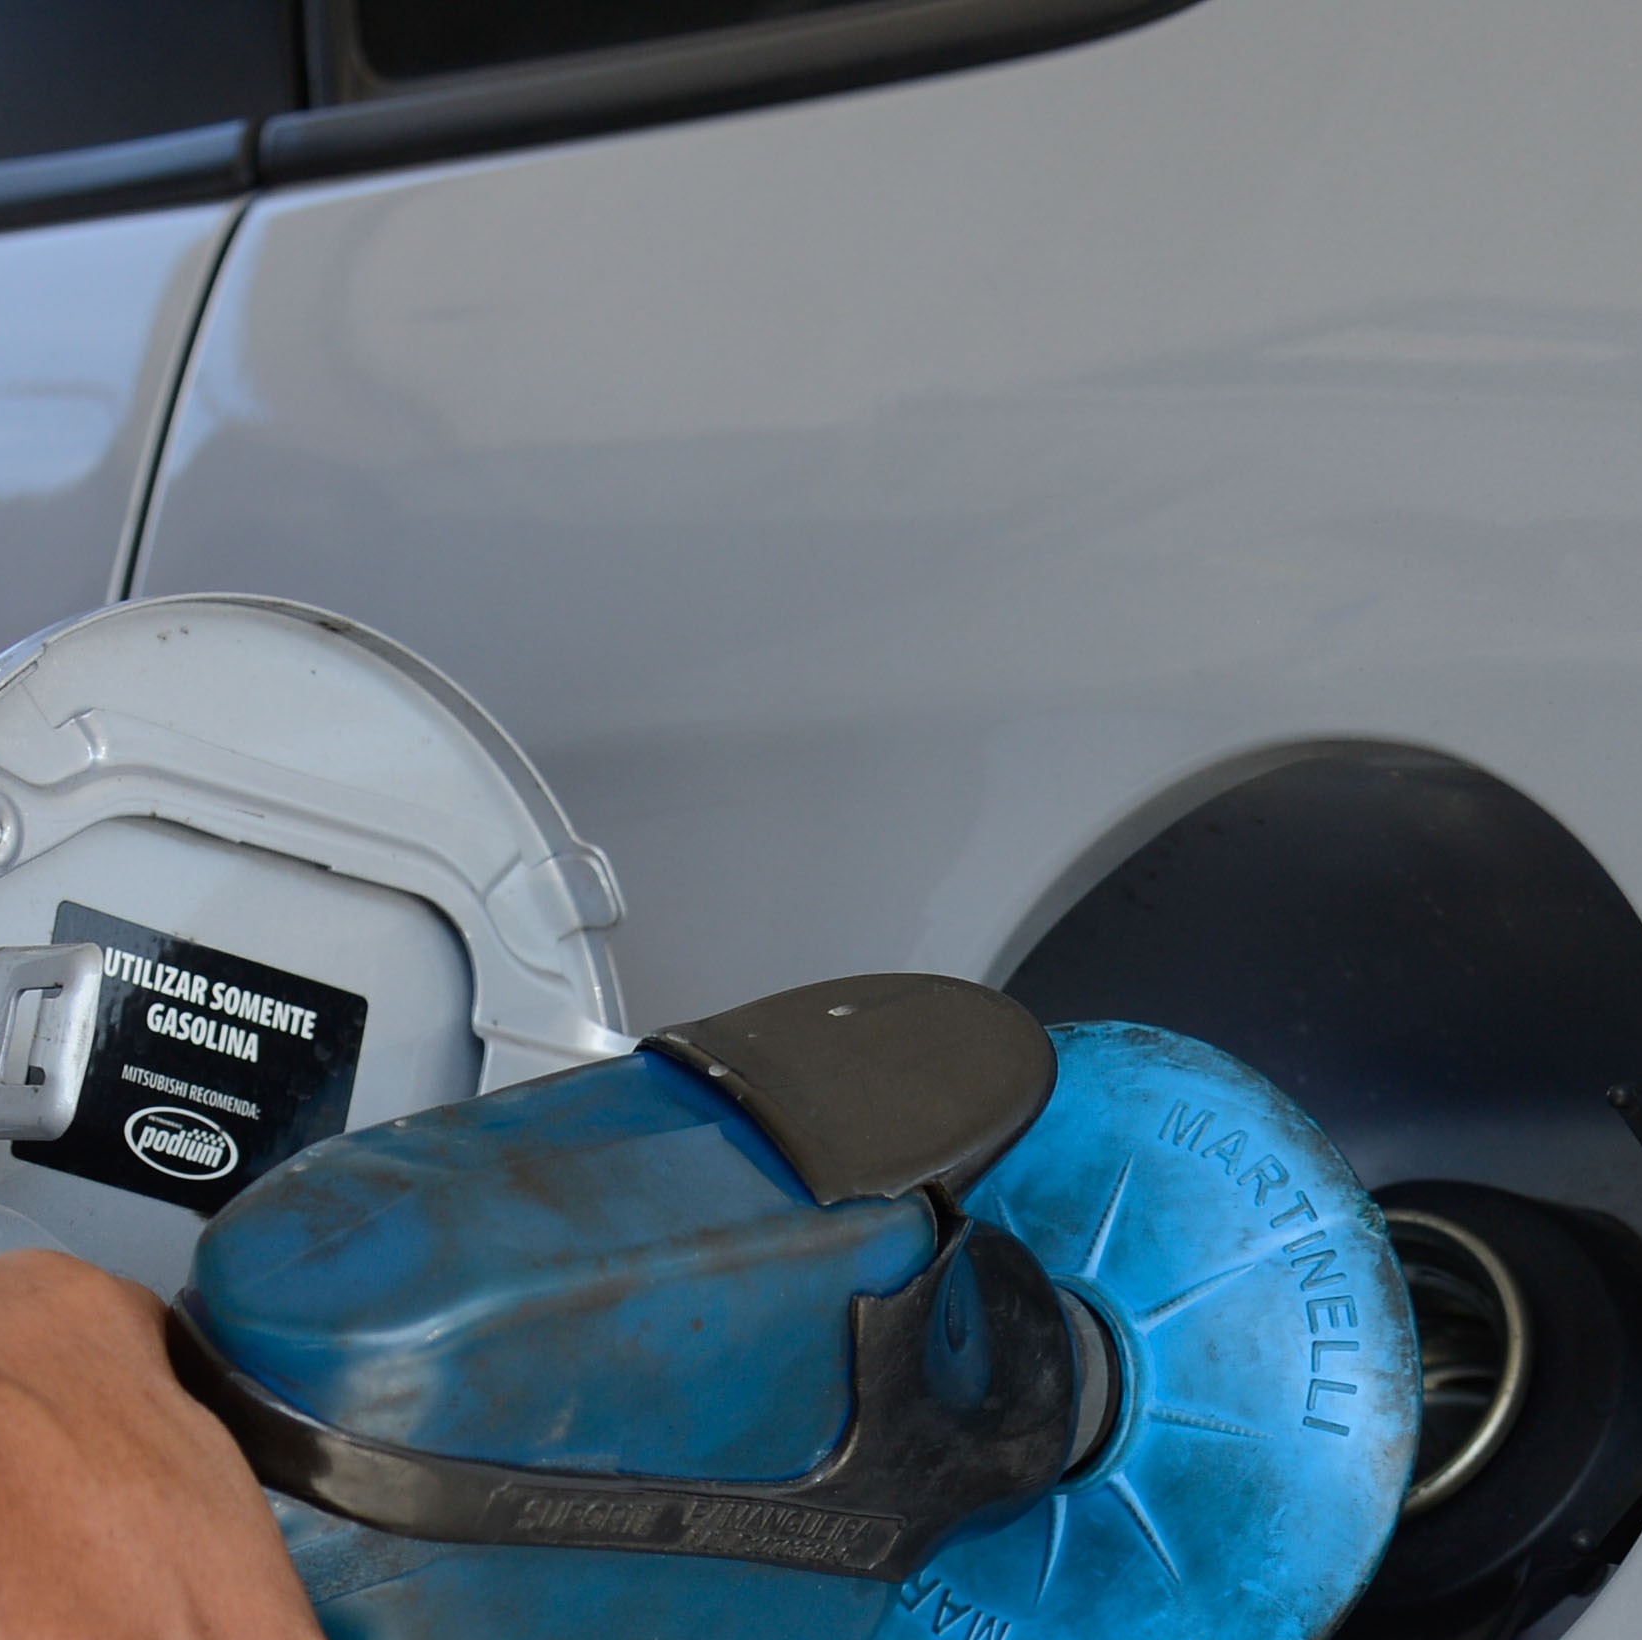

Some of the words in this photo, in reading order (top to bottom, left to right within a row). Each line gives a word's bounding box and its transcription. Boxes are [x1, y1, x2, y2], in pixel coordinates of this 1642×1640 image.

[104, 947, 209, 1006] UTILIZAR
[209, 982, 318, 1040] SOMENTE
[146, 1003, 259, 1063] GASOLINA
[121, 1064, 189, 1097] MITSUBISHI
[189, 1084, 262, 1120] RECOMENDA:
[136, 1125, 224, 1169] podium
[1159, 1098, 1361, 1438] MARTINELLI
